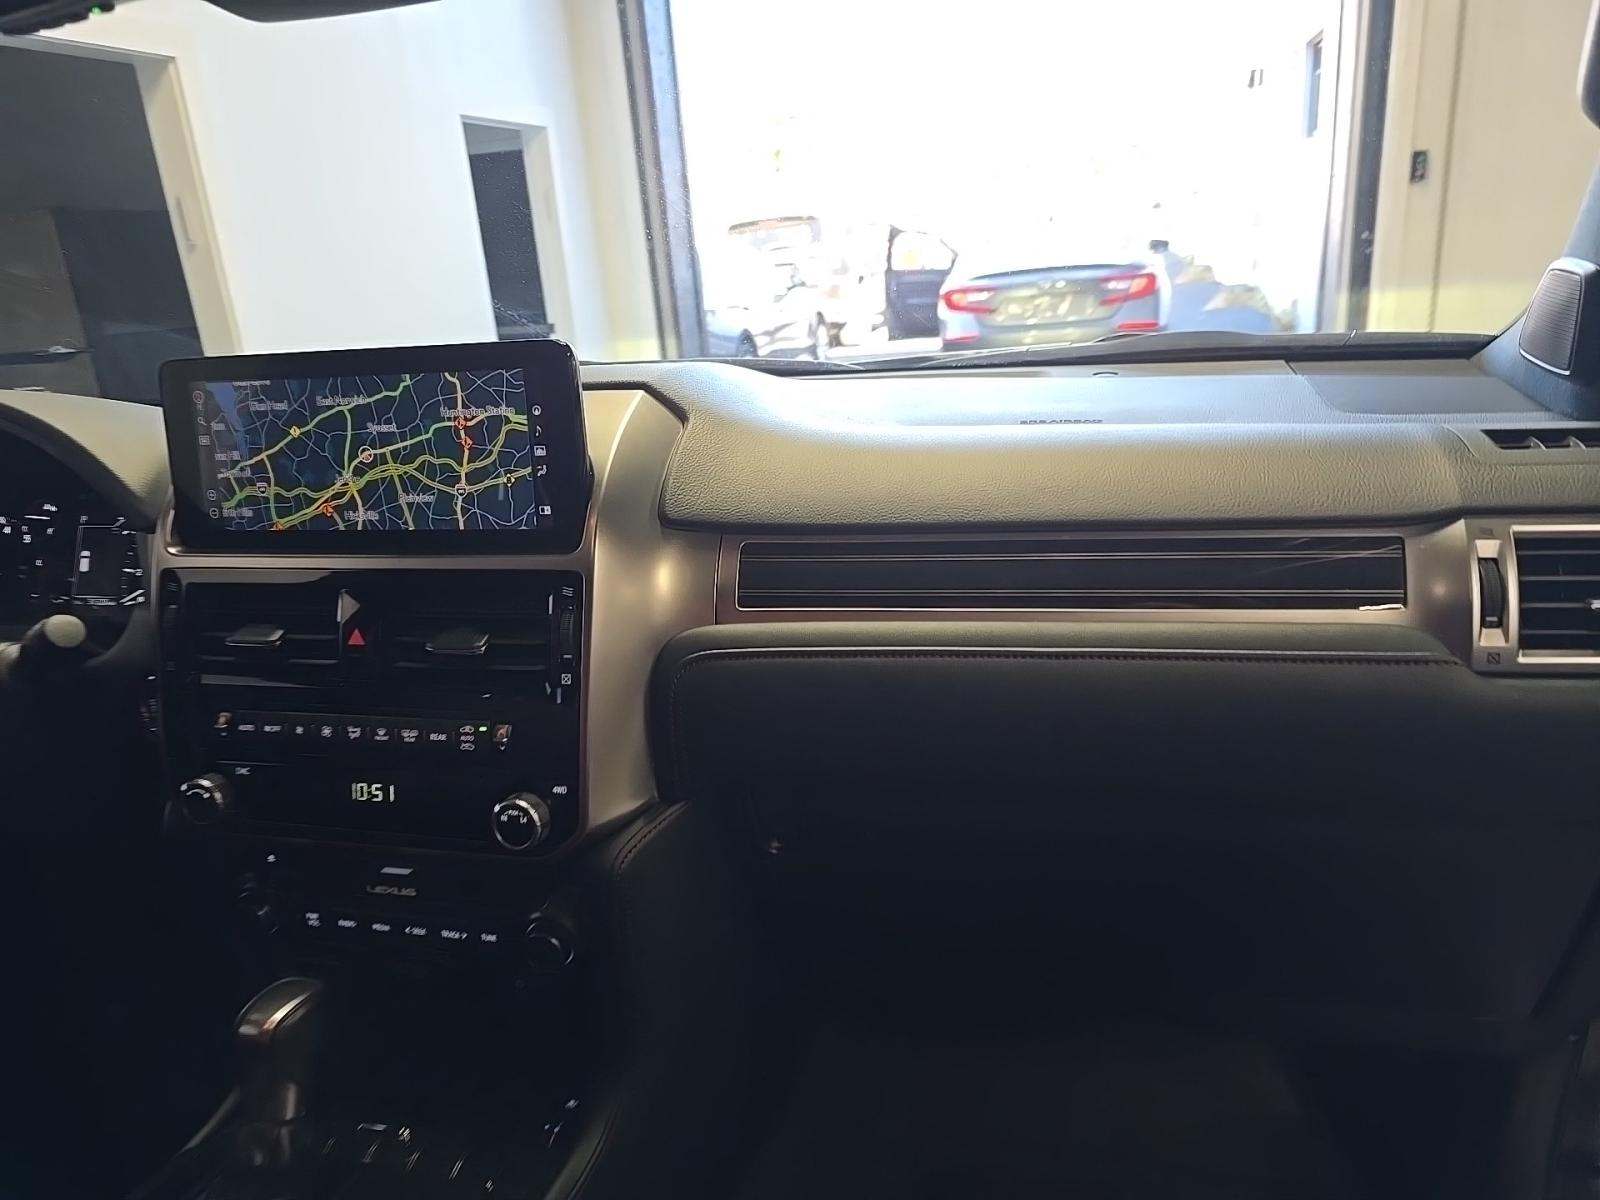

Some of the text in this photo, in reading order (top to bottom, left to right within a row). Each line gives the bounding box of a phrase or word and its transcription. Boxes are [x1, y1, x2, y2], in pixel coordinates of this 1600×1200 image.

[440, 405, 516, 418] Huntington Station
[351, 782, 395, 803] 10:51
[552, 785, 568, 795] 4WD
